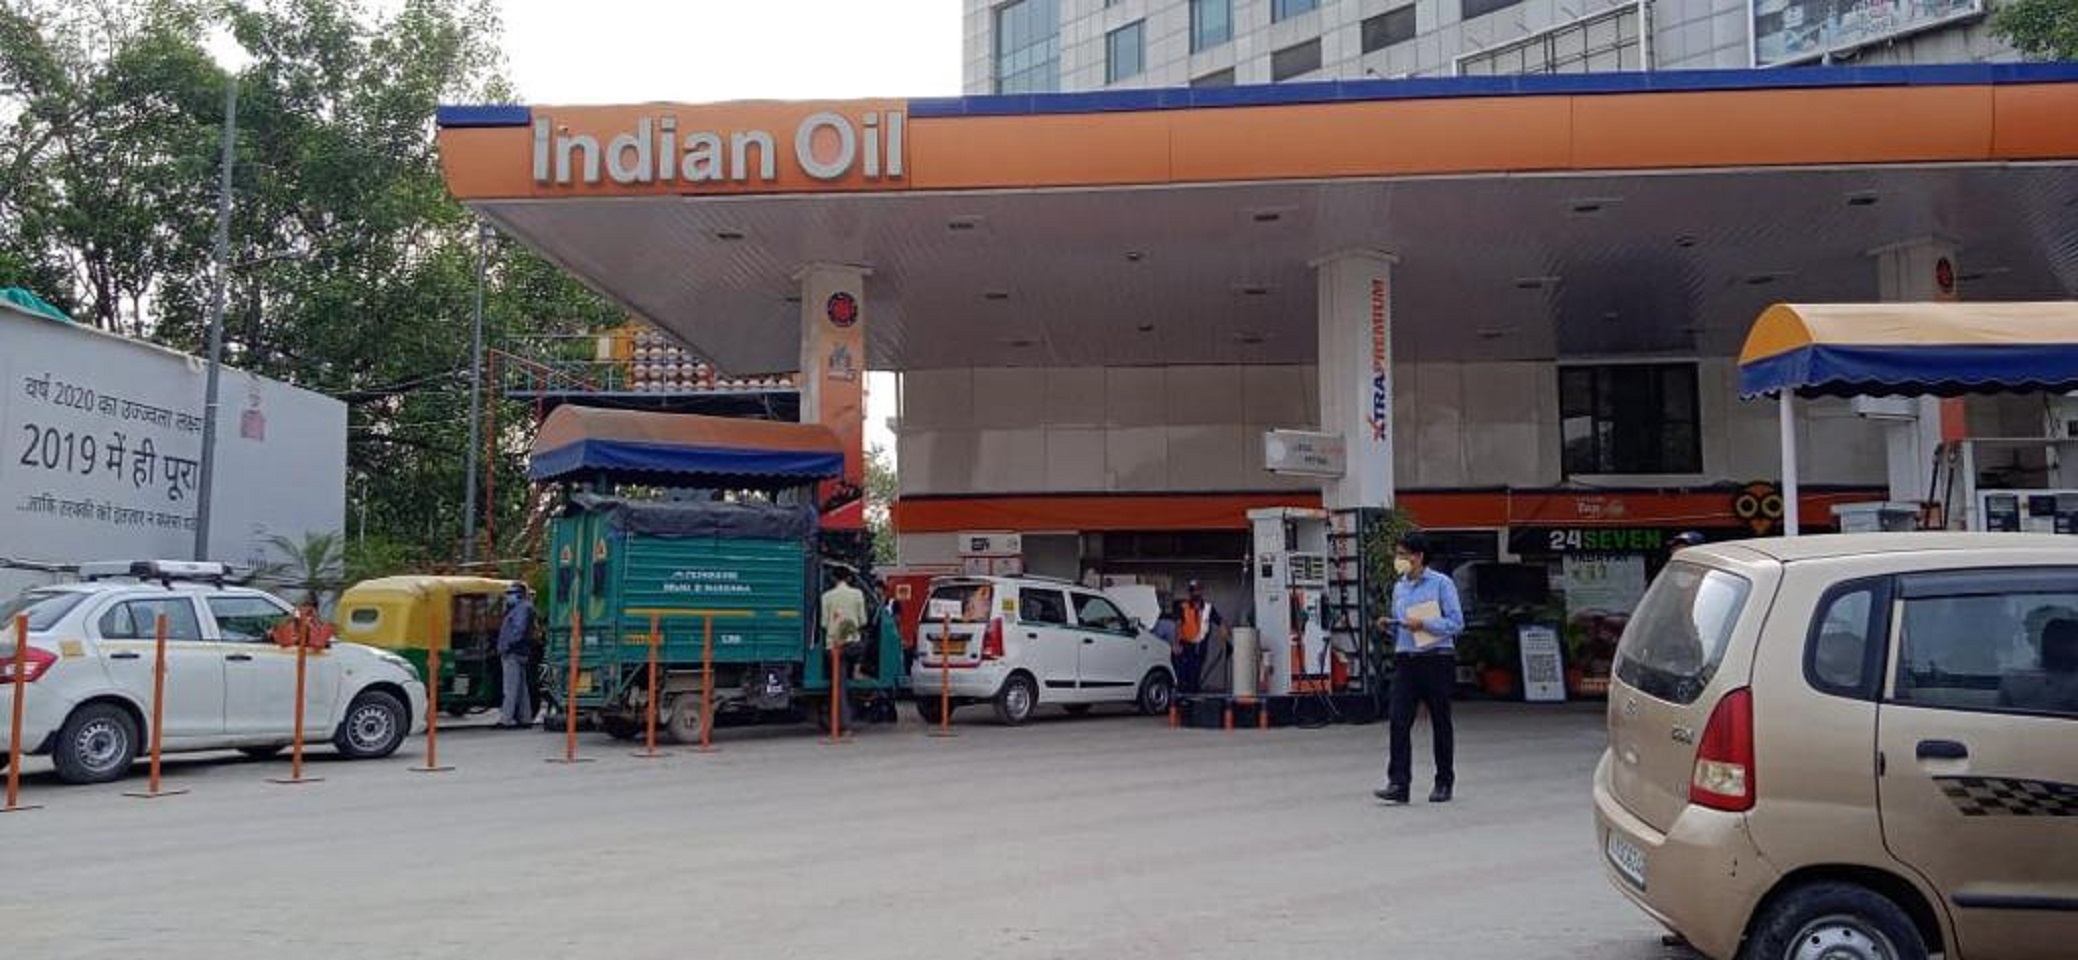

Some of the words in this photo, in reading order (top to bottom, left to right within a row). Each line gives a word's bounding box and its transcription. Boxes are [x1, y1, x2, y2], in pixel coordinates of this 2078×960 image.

[533, 114, 777, 184] Indian
[795, 110, 905, 179] Oil
[25, 373, 51, 398] वर्ष
[53, 382, 95, 412] 2020
[98, 395, 118, 416] का
[20, 424, 96, 474] 2019
[105, 431, 126, 480] में
[133, 437, 156, 488] ही
[163, 456, 198, 501] पूरा
[1549, 528, 1661, 550] 24SEVEN
